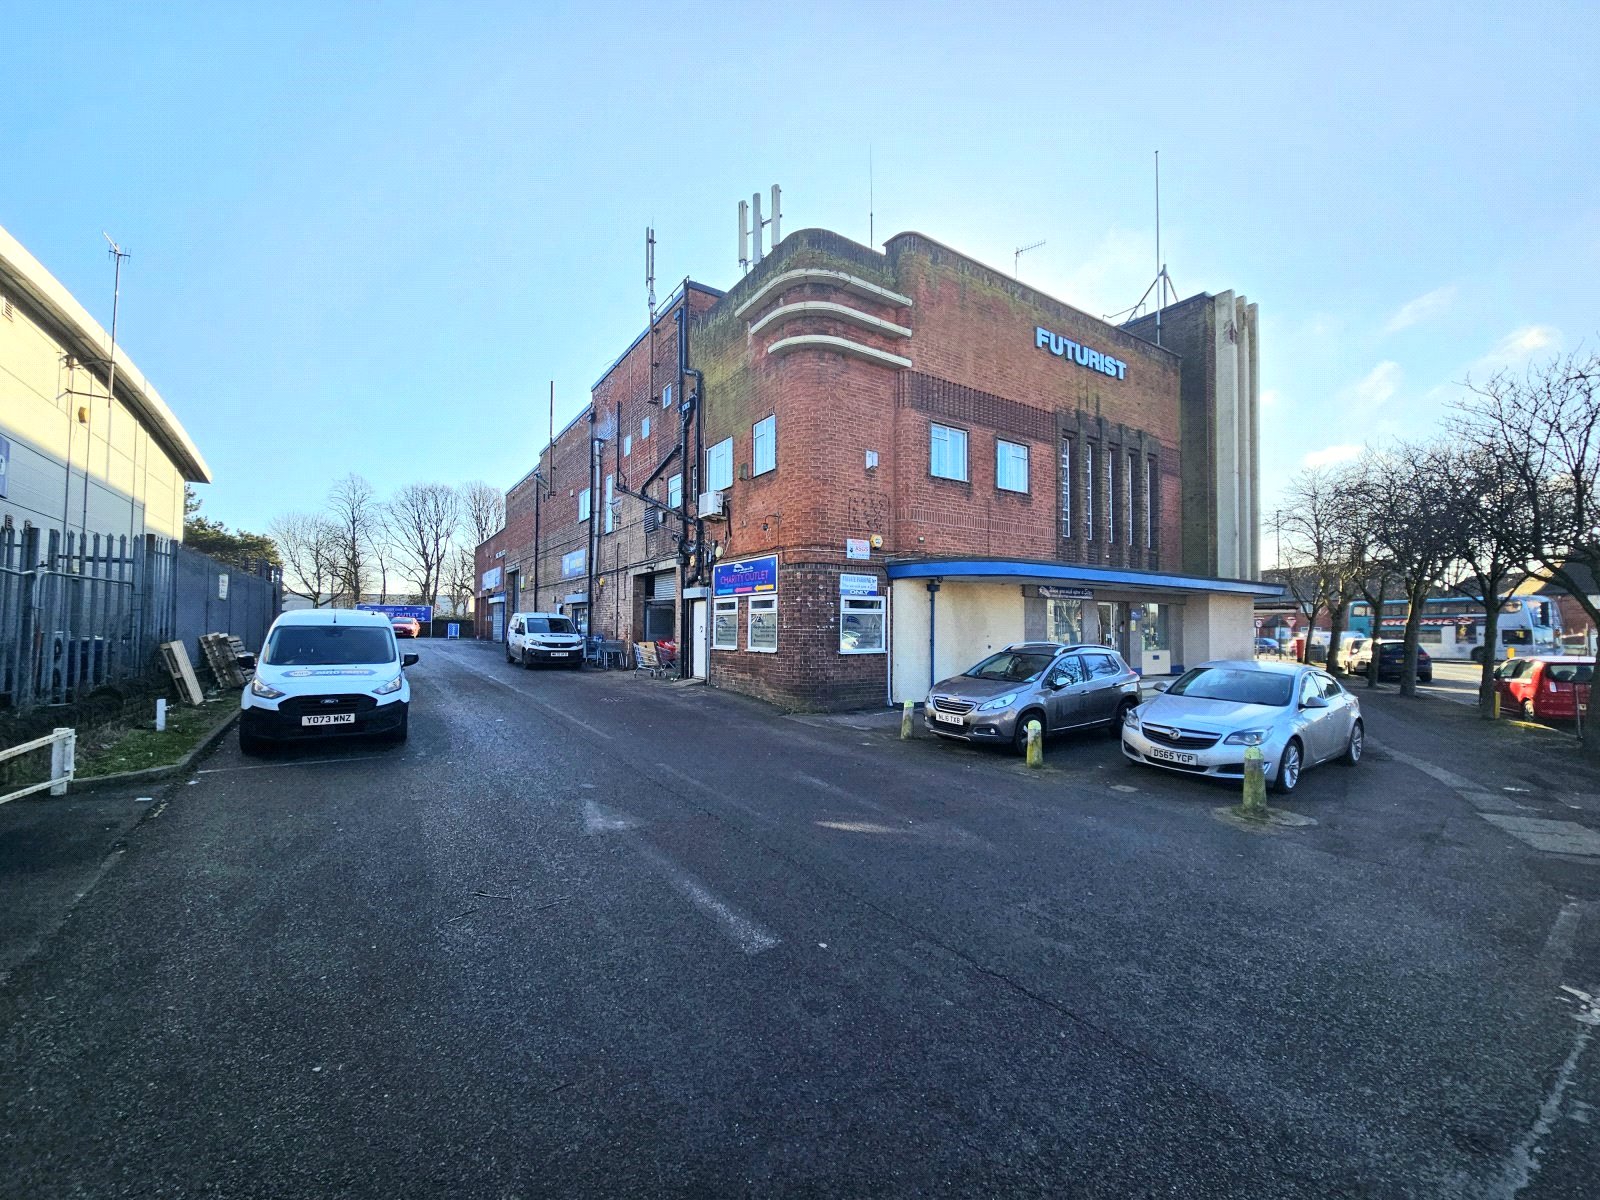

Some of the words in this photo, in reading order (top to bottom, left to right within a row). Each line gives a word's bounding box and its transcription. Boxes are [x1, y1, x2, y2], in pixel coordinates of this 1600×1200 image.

[1035, 326, 1127, 380] FUTURIST
[720, 573, 744, 585] CHARITY
[744, 569, 769, 582] OUTLET
[307, 715, 330, 723] YO73
[333, 714, 351, 722] WNZ
[1153, 749, 1174, 760] DS65
